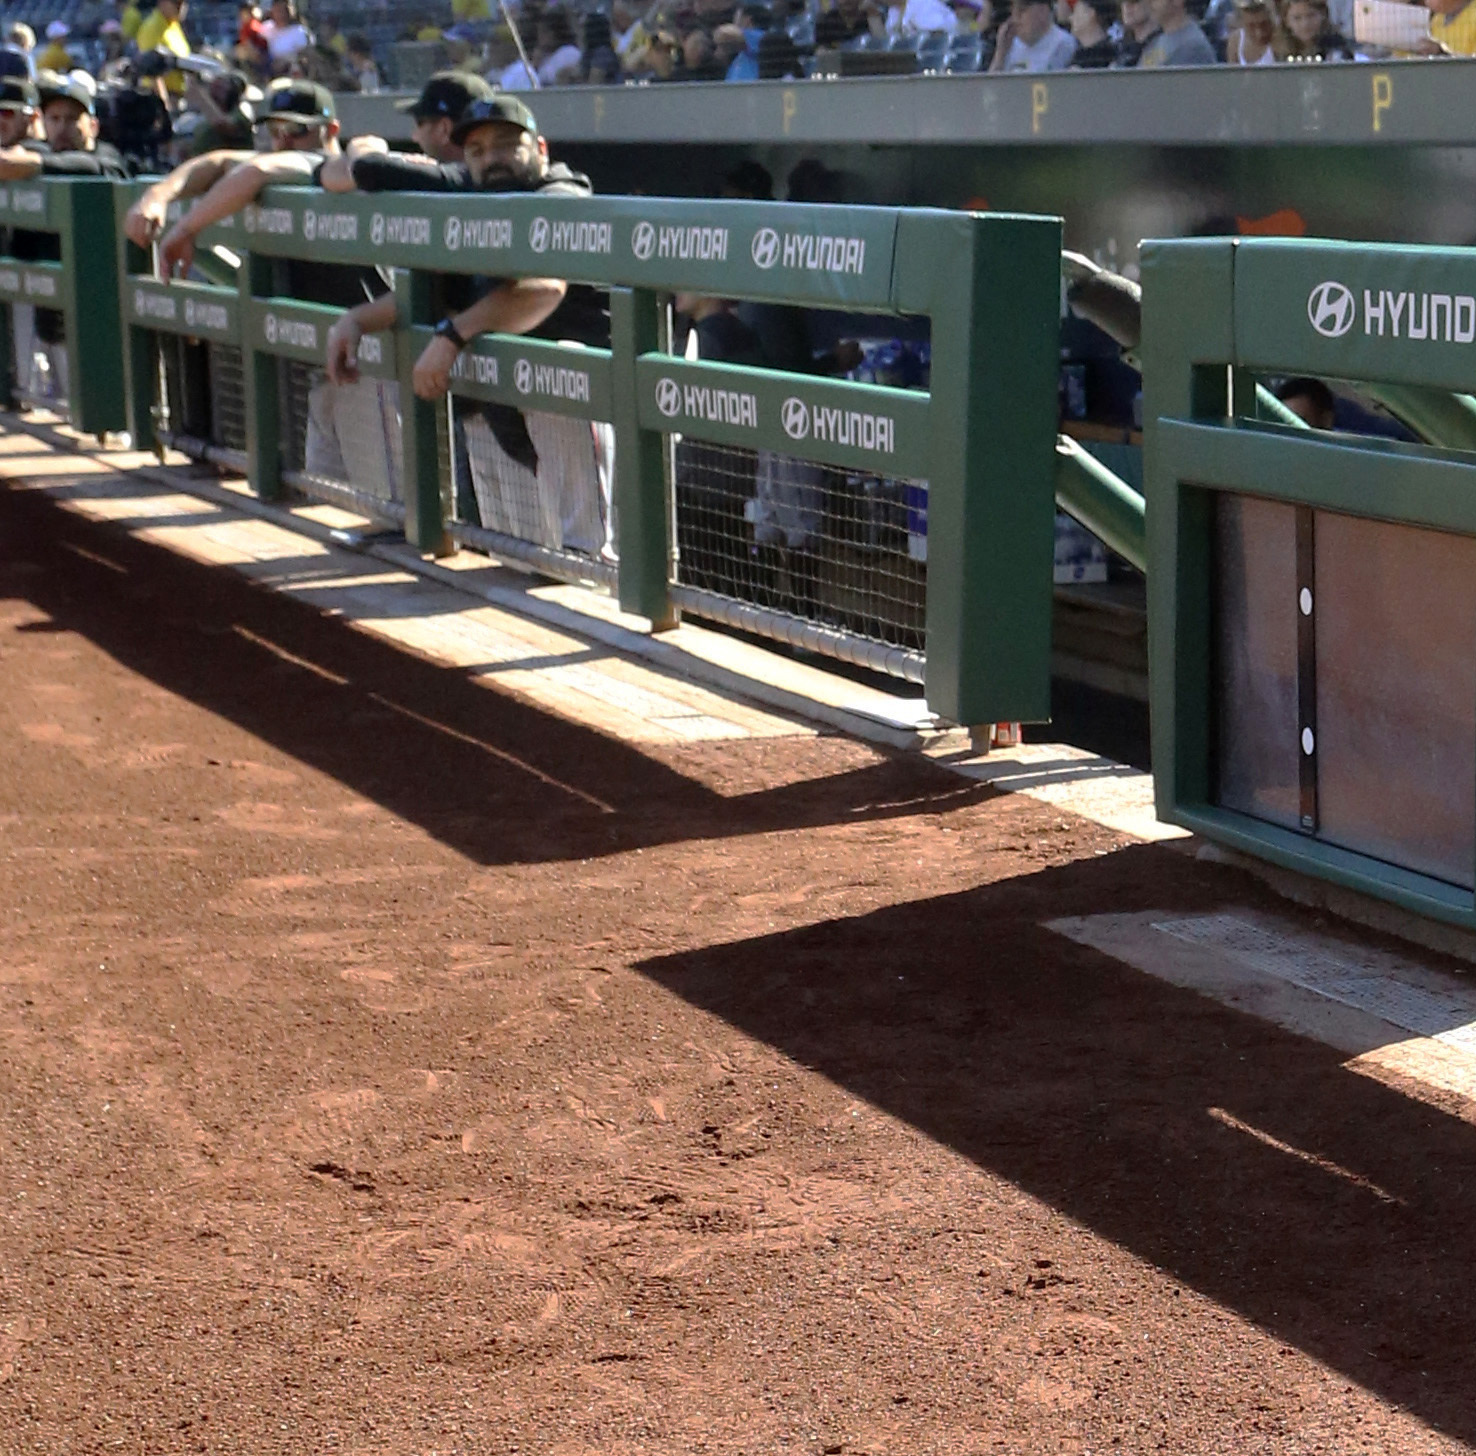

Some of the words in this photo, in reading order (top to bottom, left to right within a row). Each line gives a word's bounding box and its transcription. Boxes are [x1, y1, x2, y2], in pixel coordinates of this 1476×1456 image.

[1031, 83, 1048, 134] P
[1372, 73, 1394, 132] P
[386, 217, 431, 245] HYUNDAI
[463, 219, 512, 249] HYUNDAI
[551, 220, 612, 254] HYUNDAI
[658, 226, 728, 261] HYUNDAI
[782, 233, 866, 275] HYUNDAI
[535, 362, 590, 402] HYUNDAI
[684, 384, 758, 429] HYUNDAI
[813, 405, 895, 453] HYUNDAI
